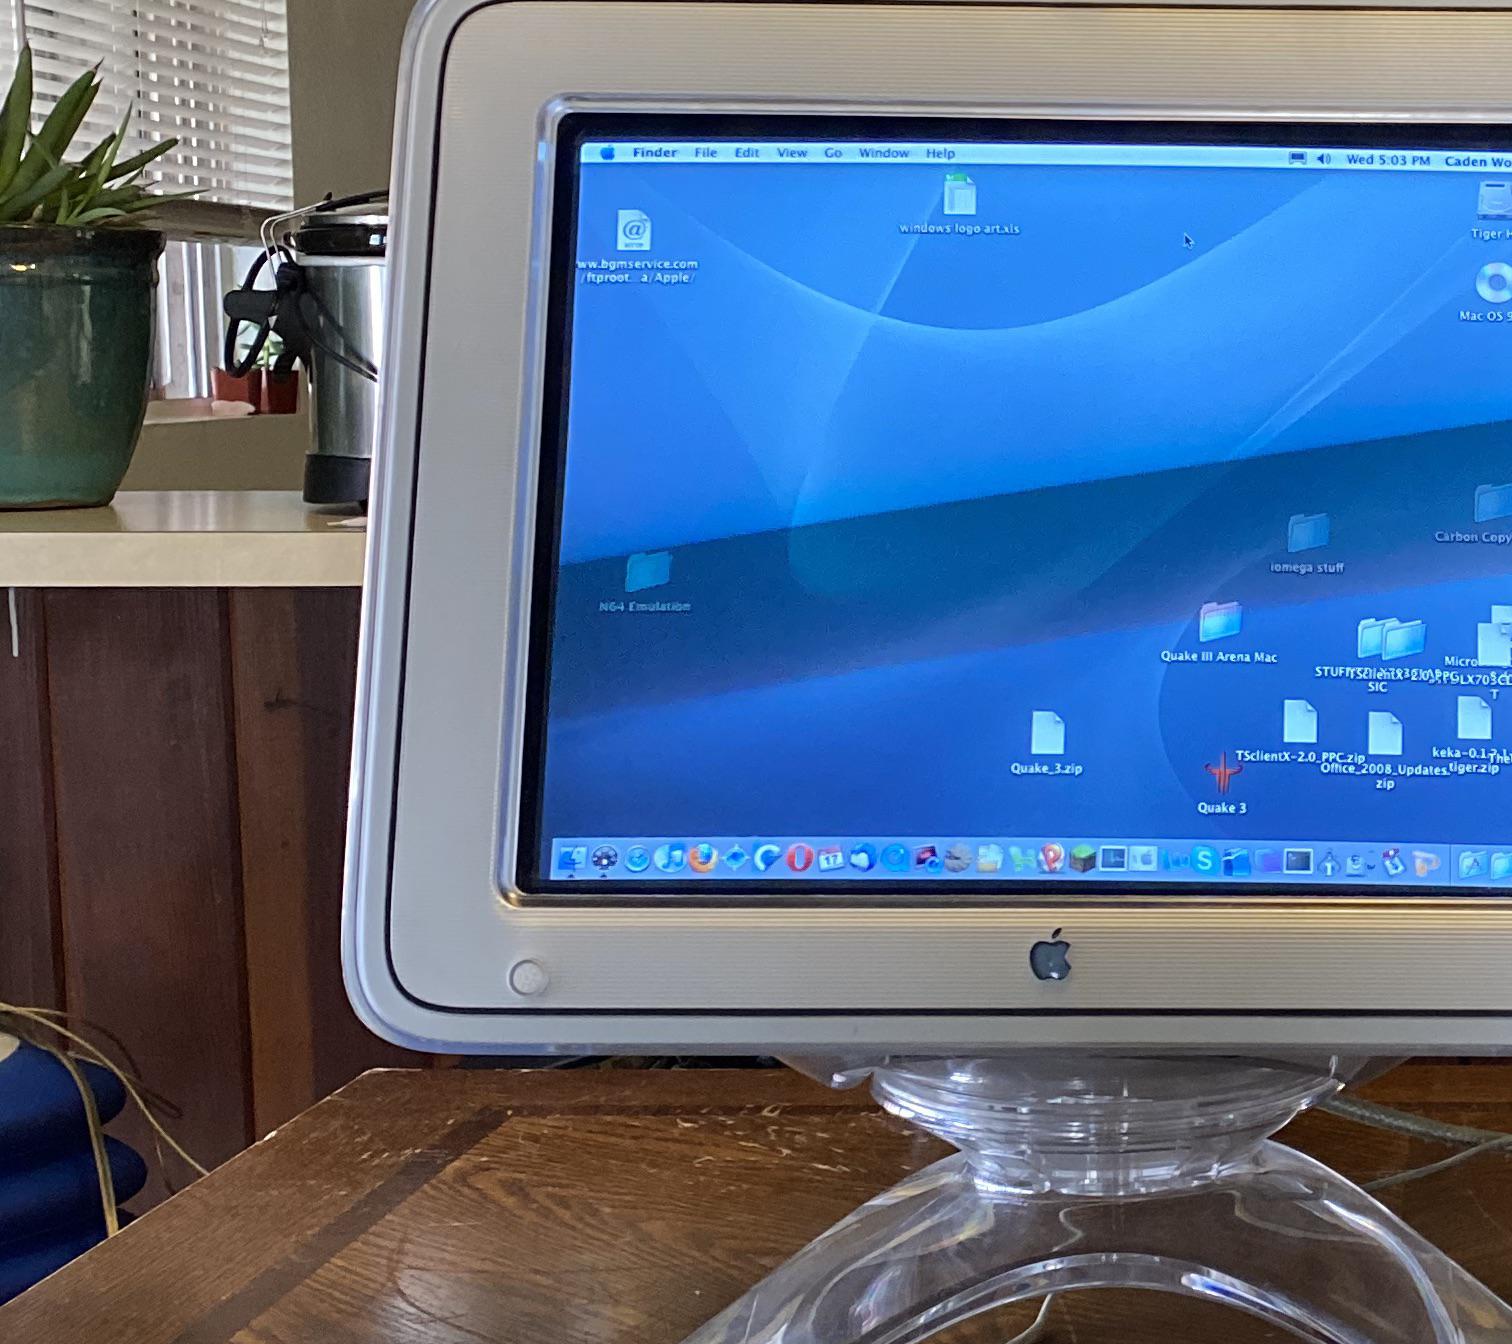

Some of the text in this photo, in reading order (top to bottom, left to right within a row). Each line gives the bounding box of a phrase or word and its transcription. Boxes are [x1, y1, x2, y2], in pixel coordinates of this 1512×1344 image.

[633, 146, 956, 161] Finder File Edit View Go Window Help
[1346, 153, 1374, 166] Wed
[1411, 154, 1431, 167] PM
[1445, 155, 1488, 168] Caden
[899, 221, 951, 234] windows
[954, 222, 981, 236] logo
[1471, 227, 1501, 241] Tiger
[1459, 310, 1484, 322] Mac
[1487, 310, 1504, 322] OS
[1435, 530, 1479, 543] Carbon
[1482, 530, 1512, 546] Copy
[1317, 562, 1345, 573] stuff
[1160, 649, 1278, 663] Quake III Arena Mac
[1010, 762, 1083, 777] Quake_3.zip
[1375, 778, 1395, 791] zip
[1197, 802, 1247, 815] Quake 3
